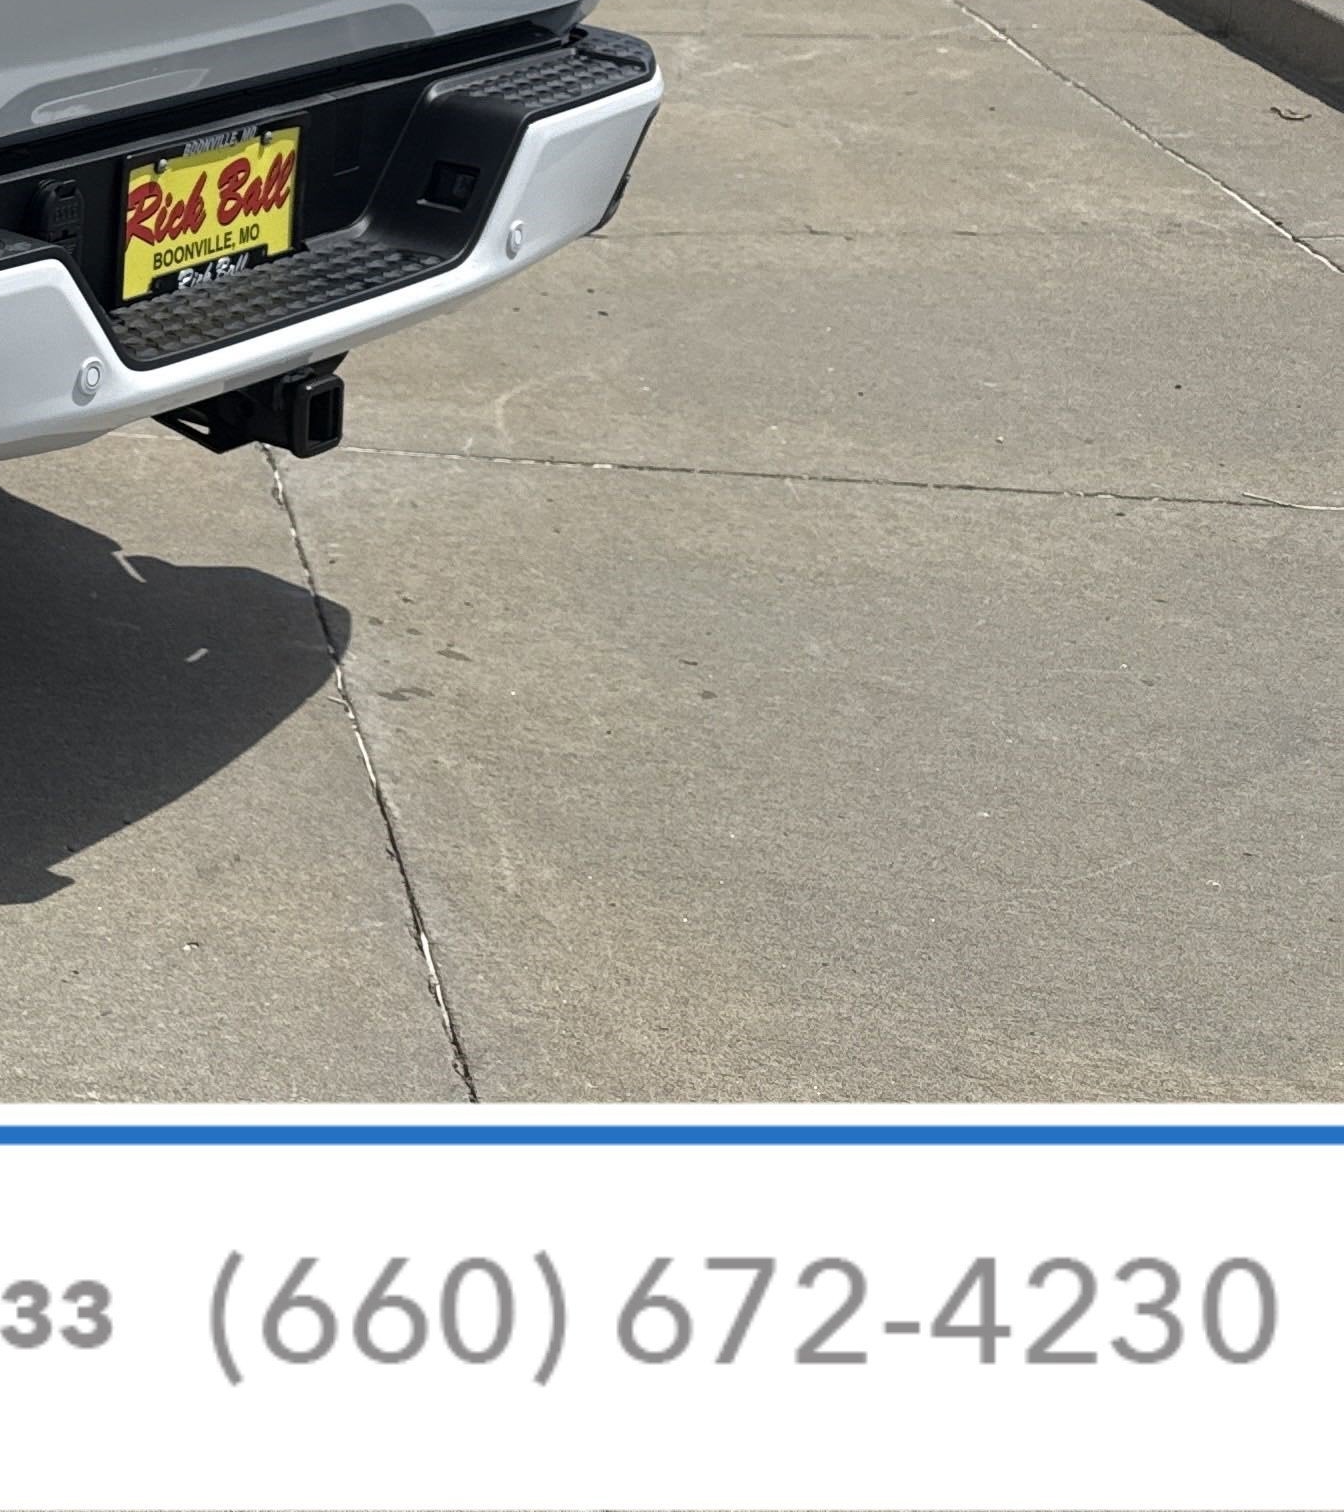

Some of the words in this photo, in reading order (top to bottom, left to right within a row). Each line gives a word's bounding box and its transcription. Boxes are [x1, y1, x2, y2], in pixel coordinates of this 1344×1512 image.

[125, 171, 208, 253] Rick
[216, 149, 296, 227] Ball
[153, 231, 236, 271] BOONVILLE,
[238, 223, 260, 245] MO
